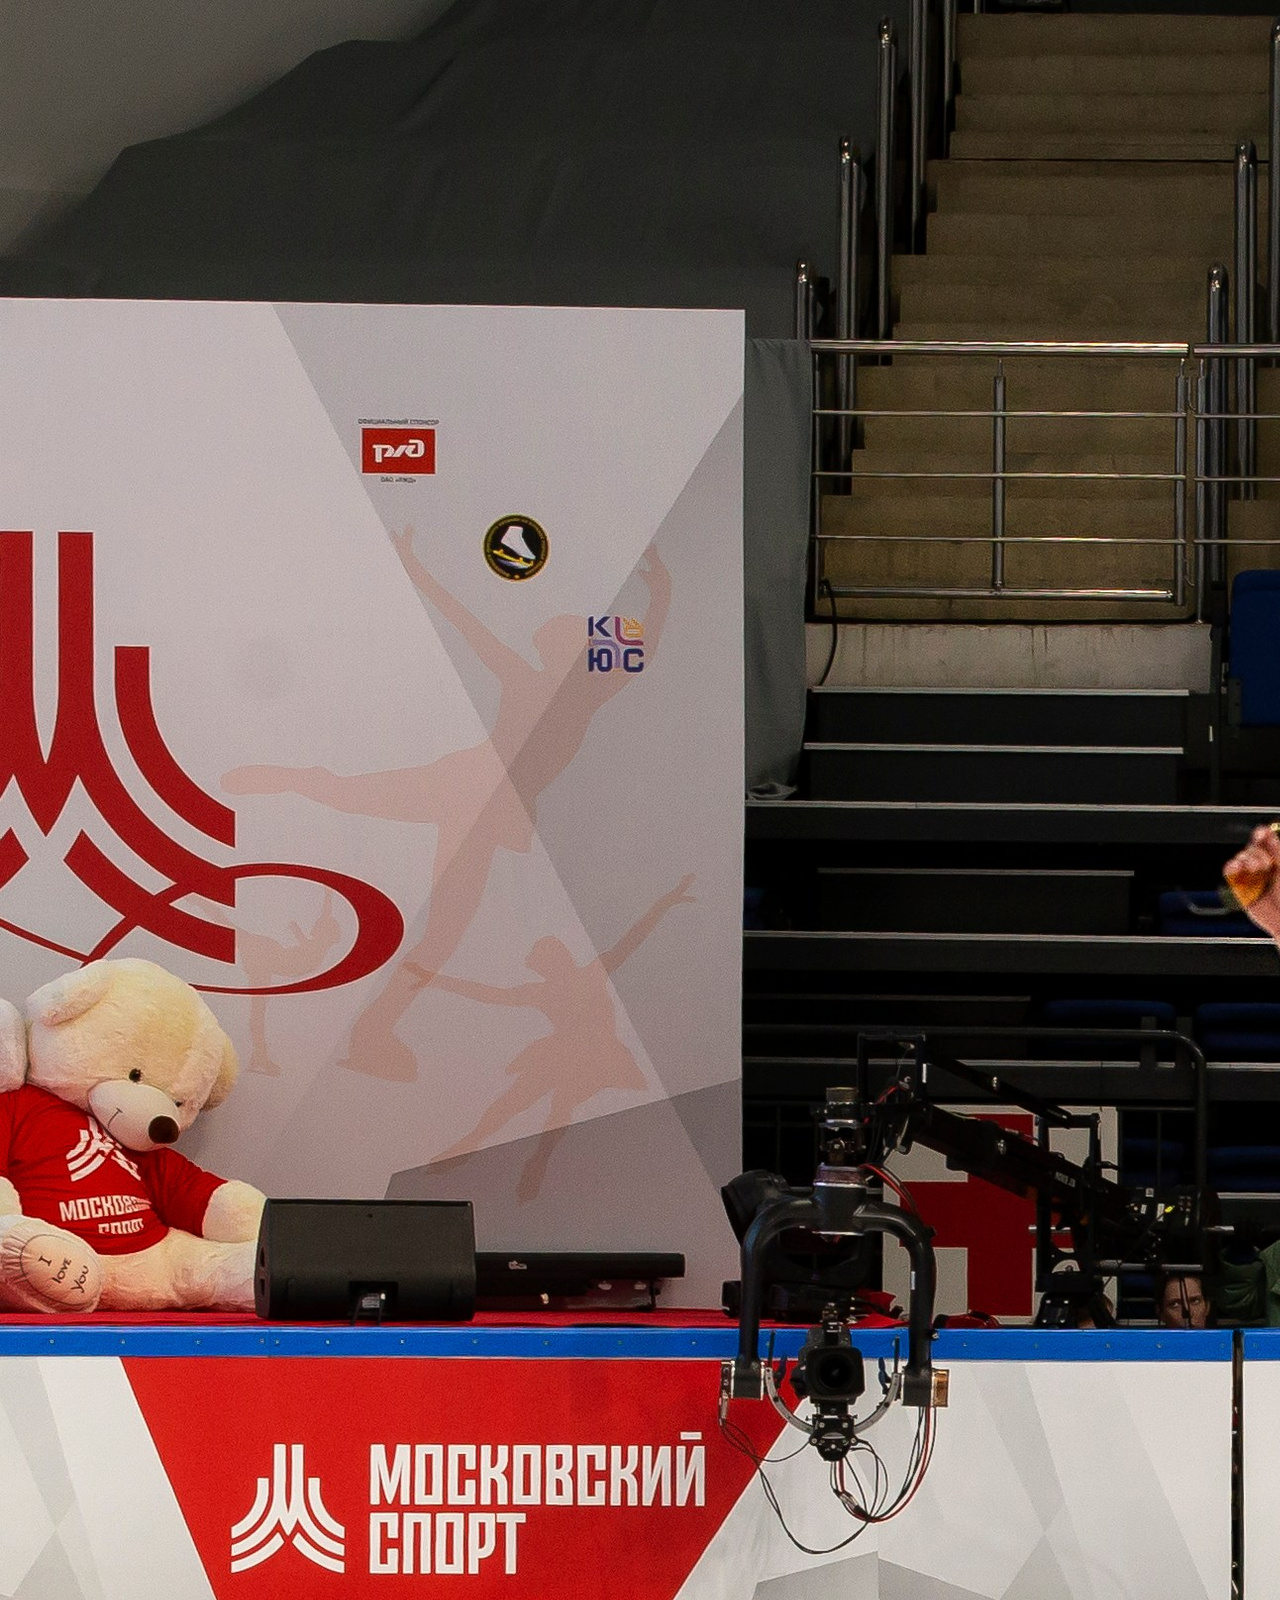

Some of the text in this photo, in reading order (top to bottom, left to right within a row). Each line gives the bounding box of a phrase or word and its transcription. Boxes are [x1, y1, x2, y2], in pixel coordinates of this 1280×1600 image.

[37, 1255, 52, 1267] I
[369, 1431, 706, 1507] МОСКОВСКИЙ
[369, 1512, 526, 1575] СПОРТ
